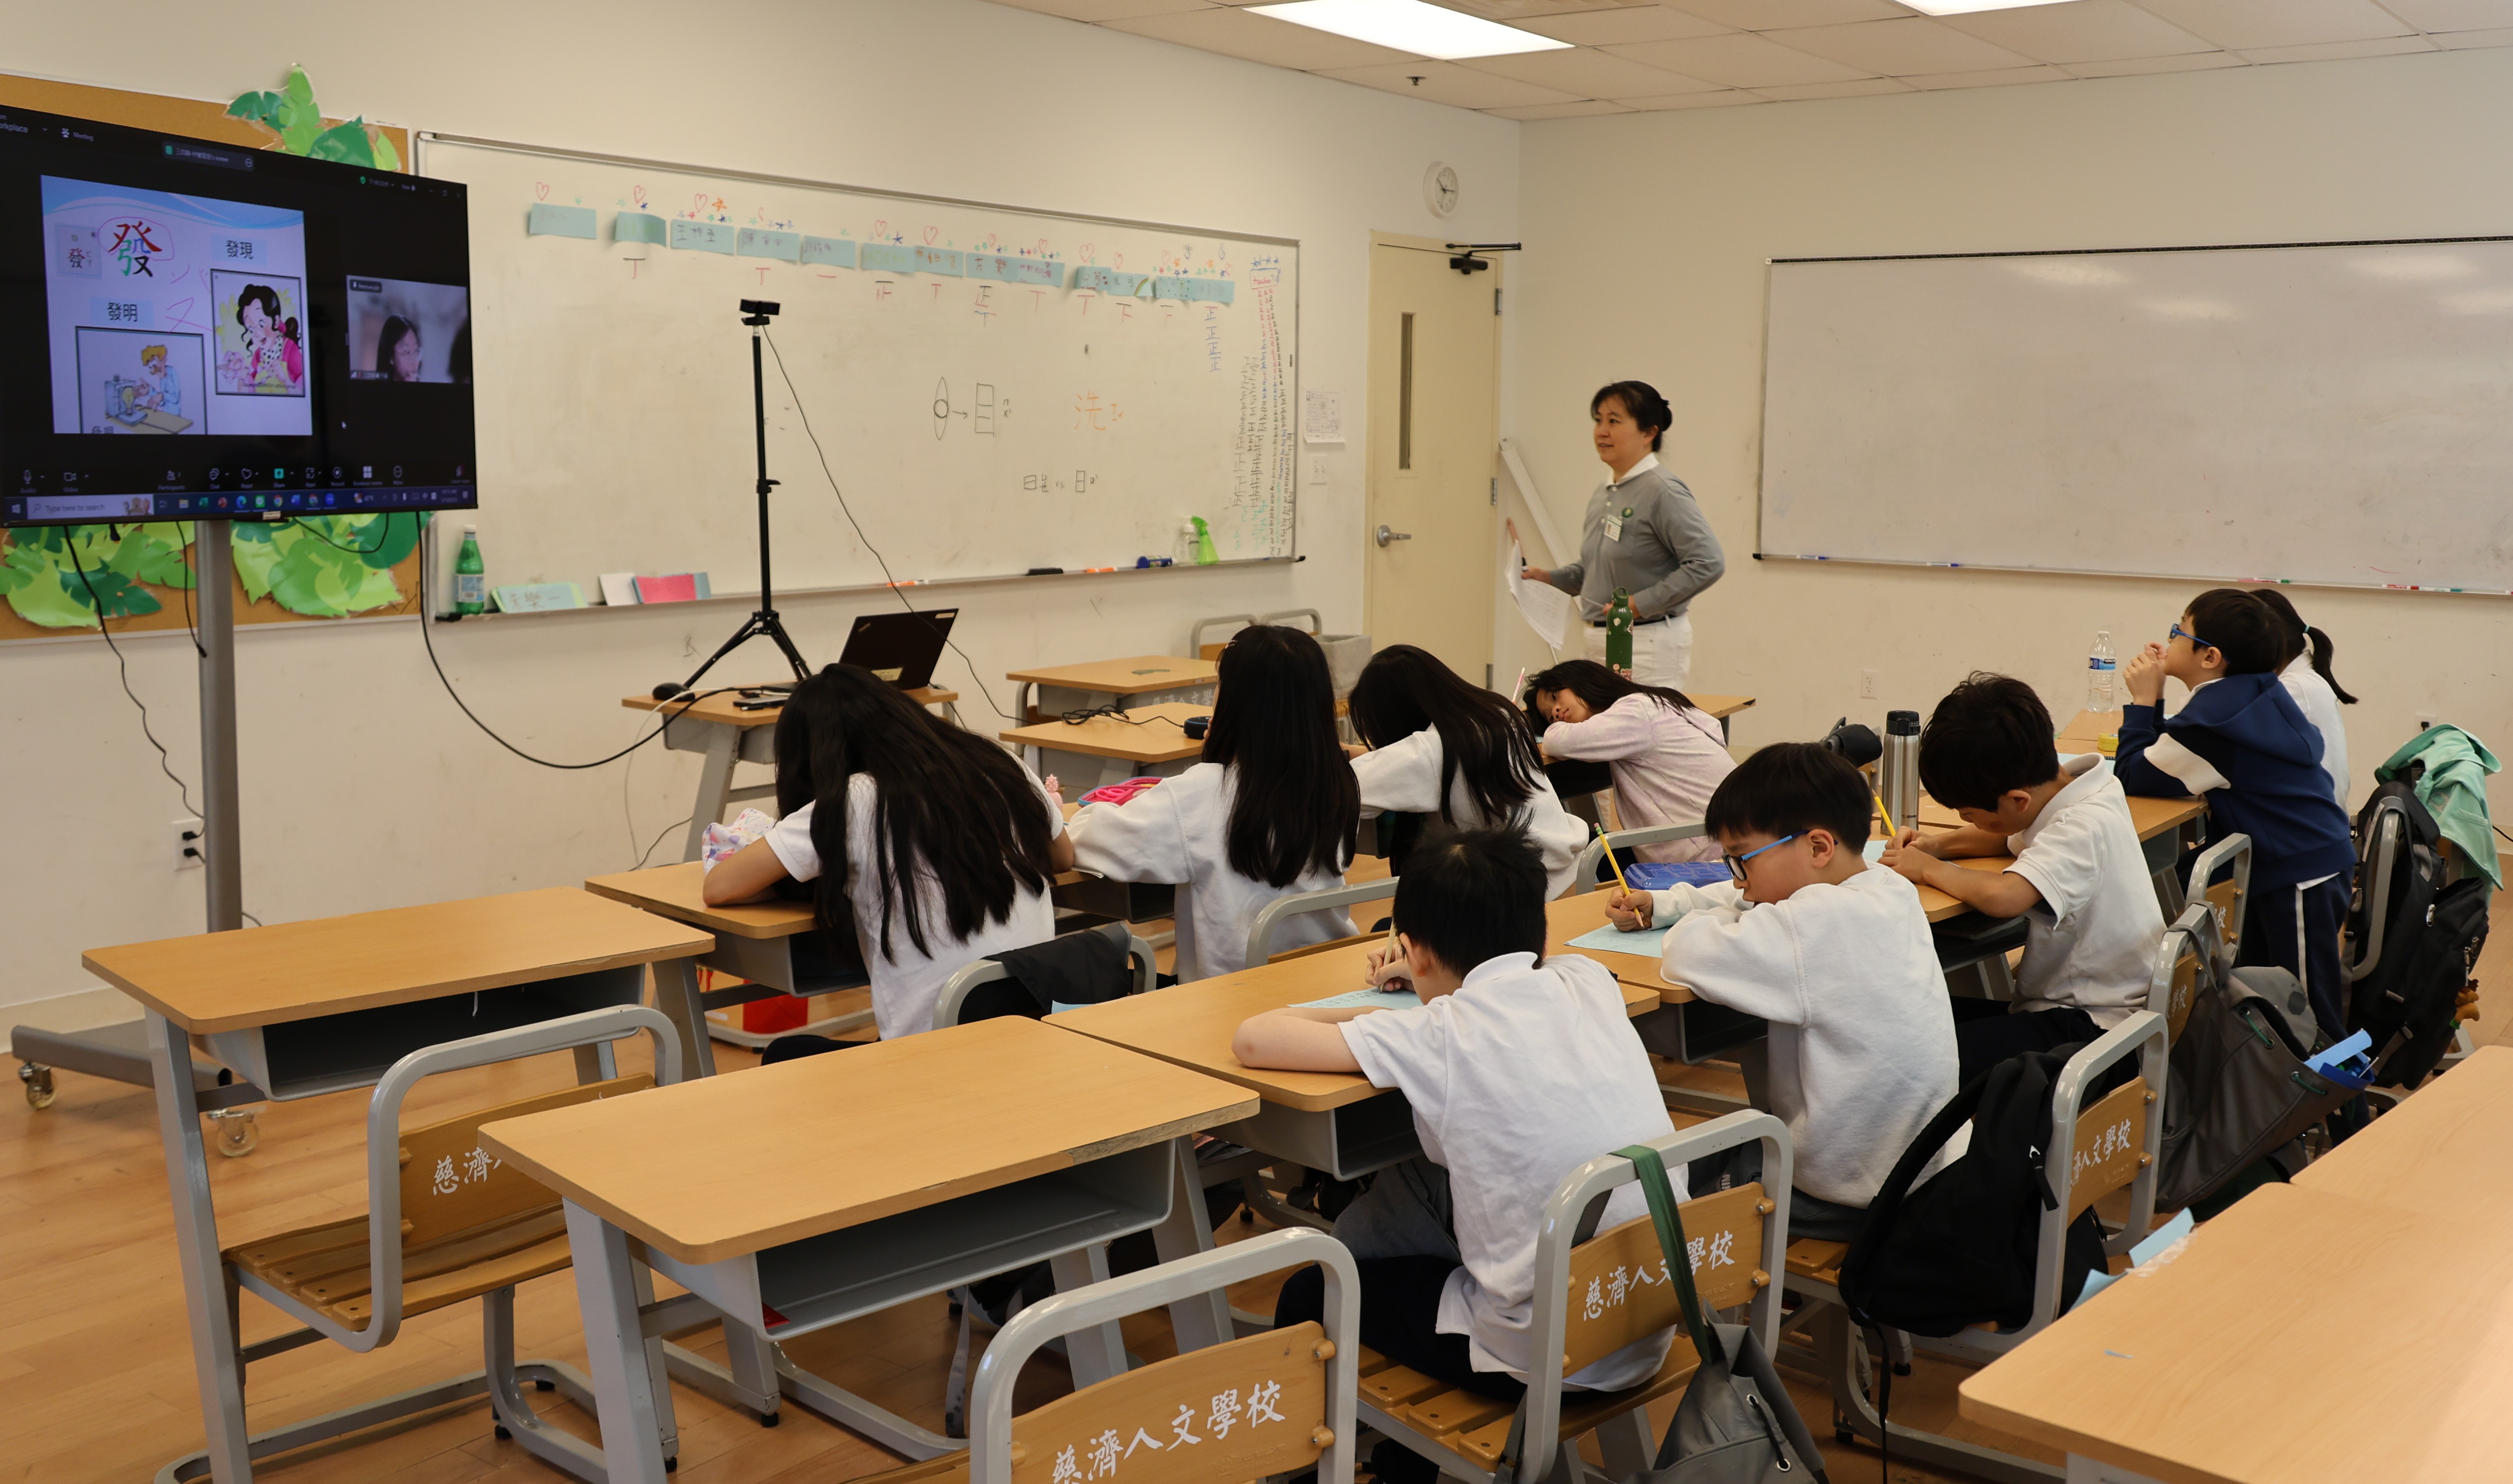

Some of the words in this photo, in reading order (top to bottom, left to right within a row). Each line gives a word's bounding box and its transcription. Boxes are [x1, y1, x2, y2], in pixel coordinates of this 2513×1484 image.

[108, 221, 163, 278] 發
[226, 240, 253, 260] 發現
[107, 302, 138, 322] 發明
[1074, 390, 1106, 430] 洗
[2215, 905, 2226, 928] 校
[2168, 984, 2187, 1019] 學校
[433, 1146, 502, 1196] 慈濟
[2069, 1118, 2131, 1194] 濟人文學校
